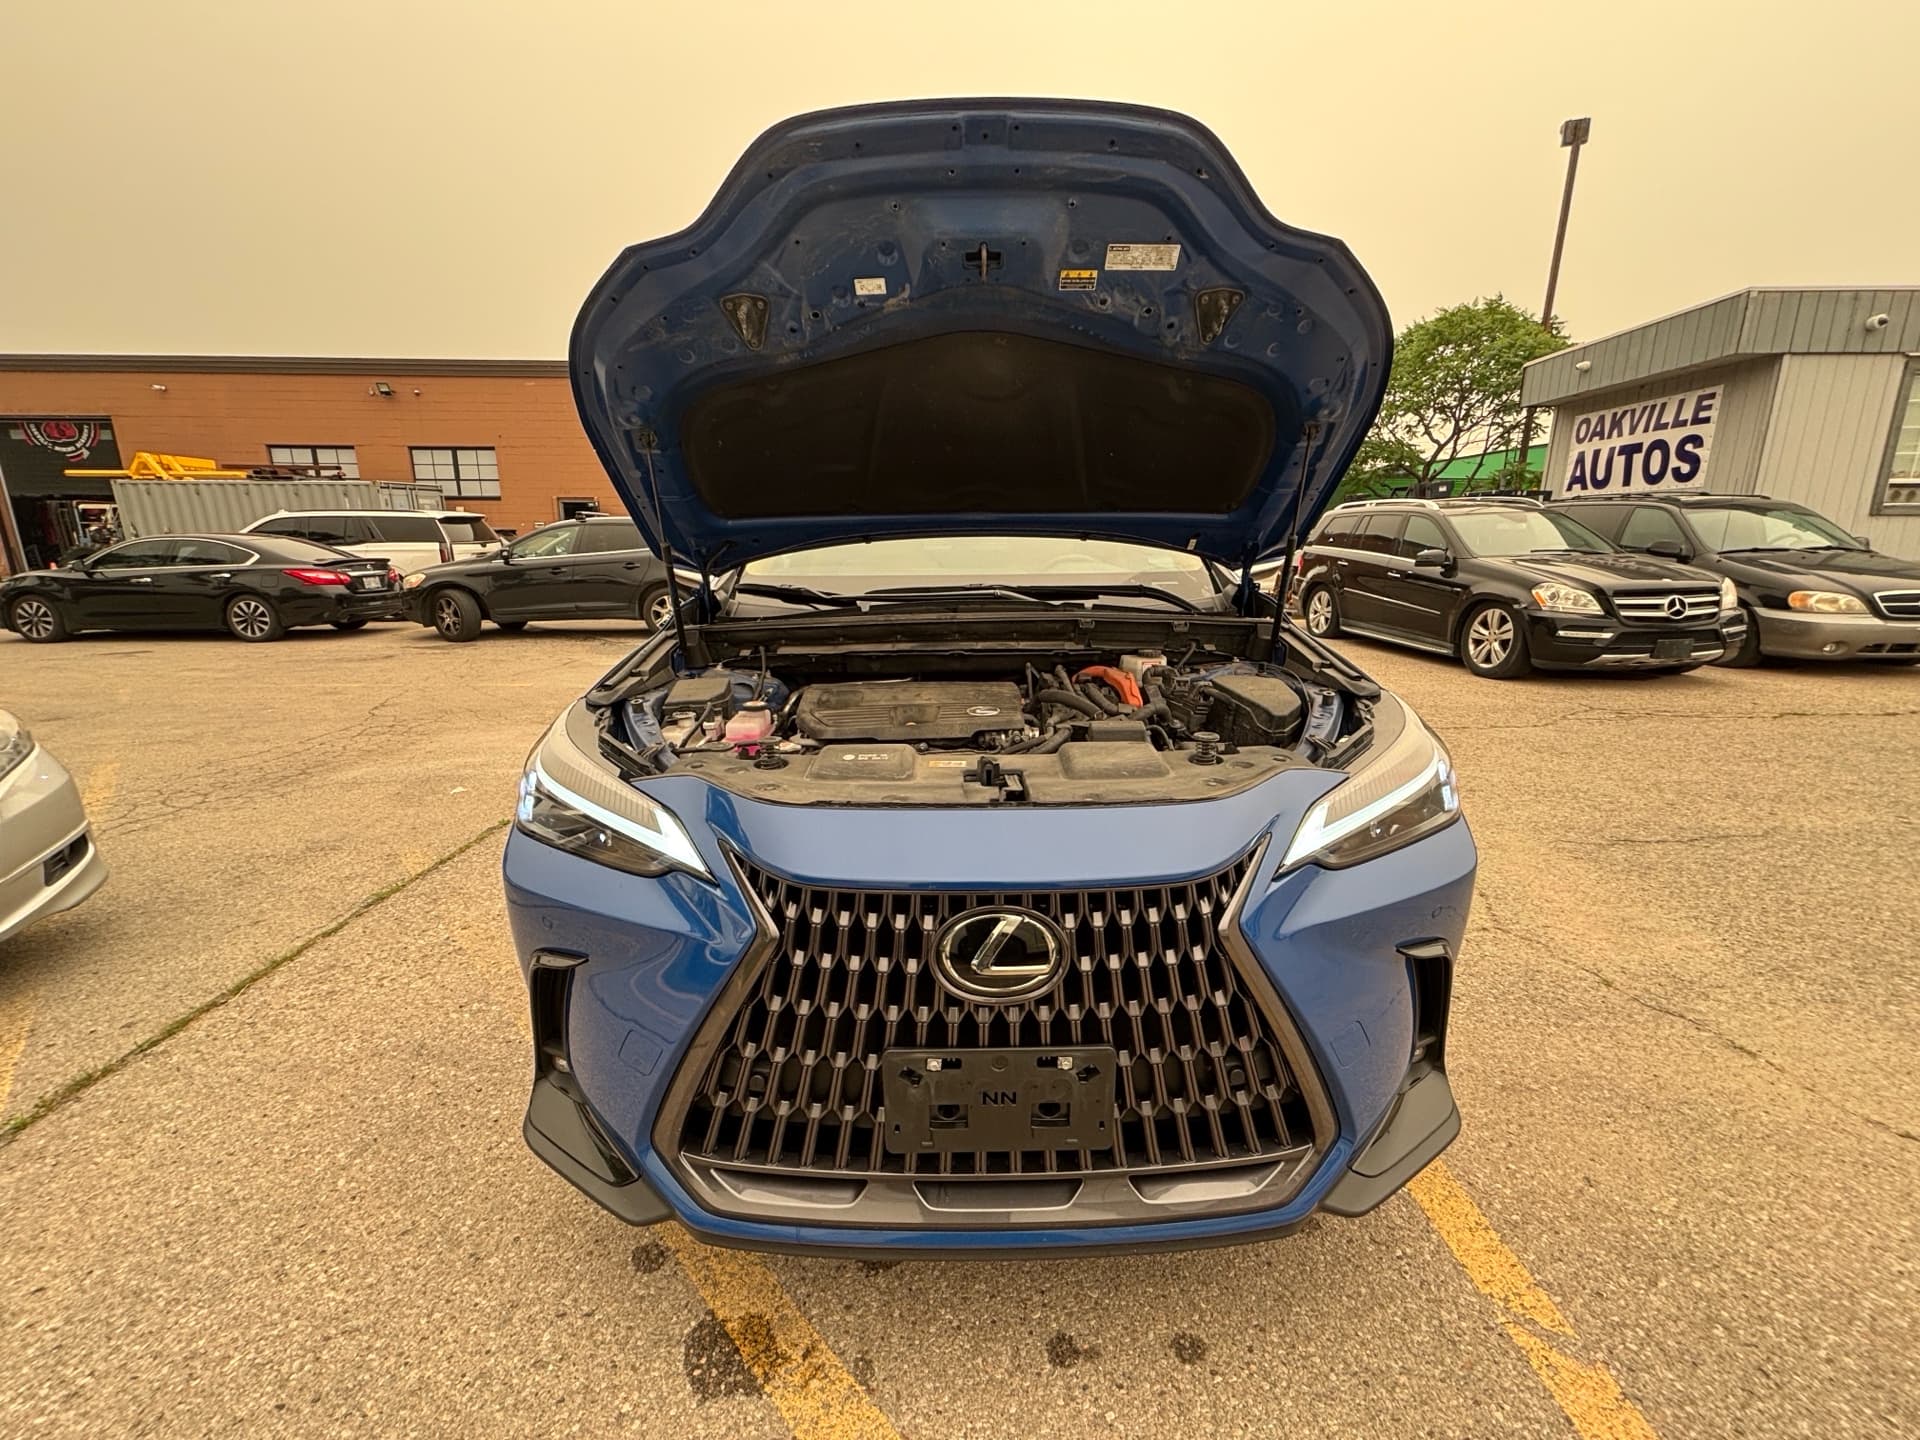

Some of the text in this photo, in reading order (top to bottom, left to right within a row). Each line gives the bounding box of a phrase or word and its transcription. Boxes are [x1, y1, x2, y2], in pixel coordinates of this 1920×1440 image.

[1575, 392, 1716, 445] OAKVILLE
[1565, 433, 1705, 492] AUTOS
[981, 1090, 1017, 1106] NN
